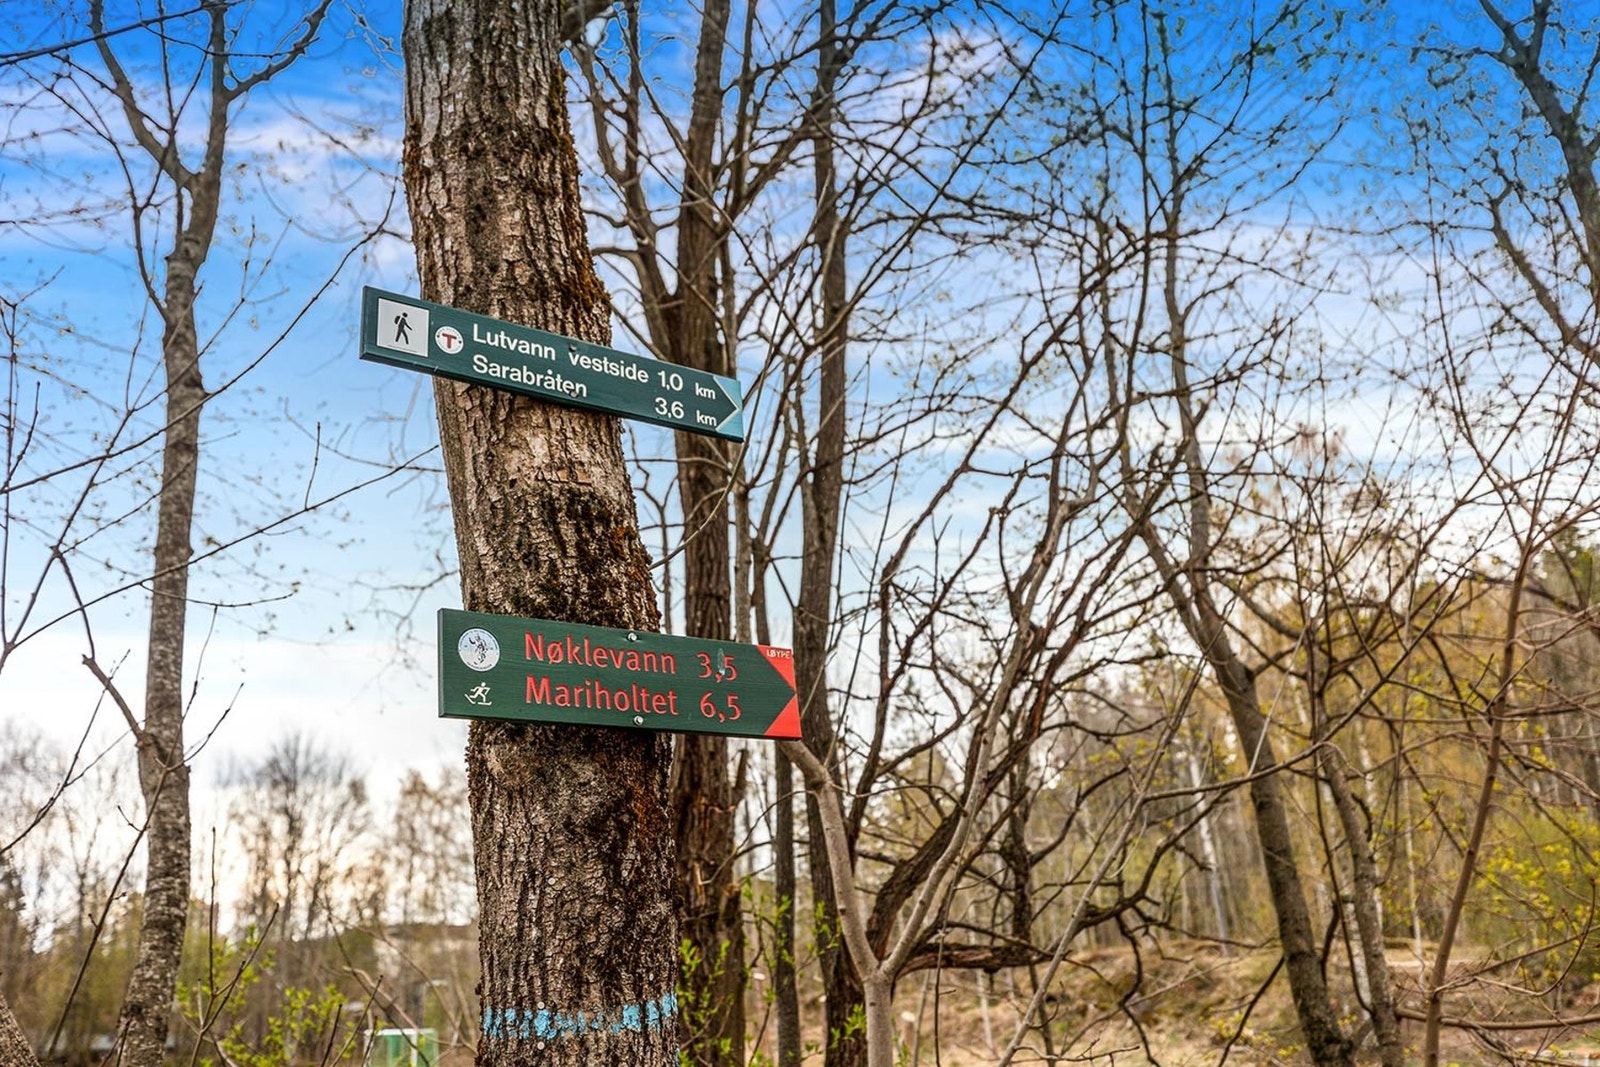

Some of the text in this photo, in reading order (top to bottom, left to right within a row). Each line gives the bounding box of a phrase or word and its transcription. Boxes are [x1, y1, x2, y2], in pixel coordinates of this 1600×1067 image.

[442, 333, 457, 349] T
[473, 323, 556, 361] Lutvann
[568, 351, 649, 383] vestside
[695, 382, 716, 400] km
[473, 354, 717, 427] Sarabråten 3,6 km
[524, 631, 677, 675] Nøklevann
[696, 651, 738, 683] 3,5
[525, 675, 742, 723] Mariholtet 6,5
